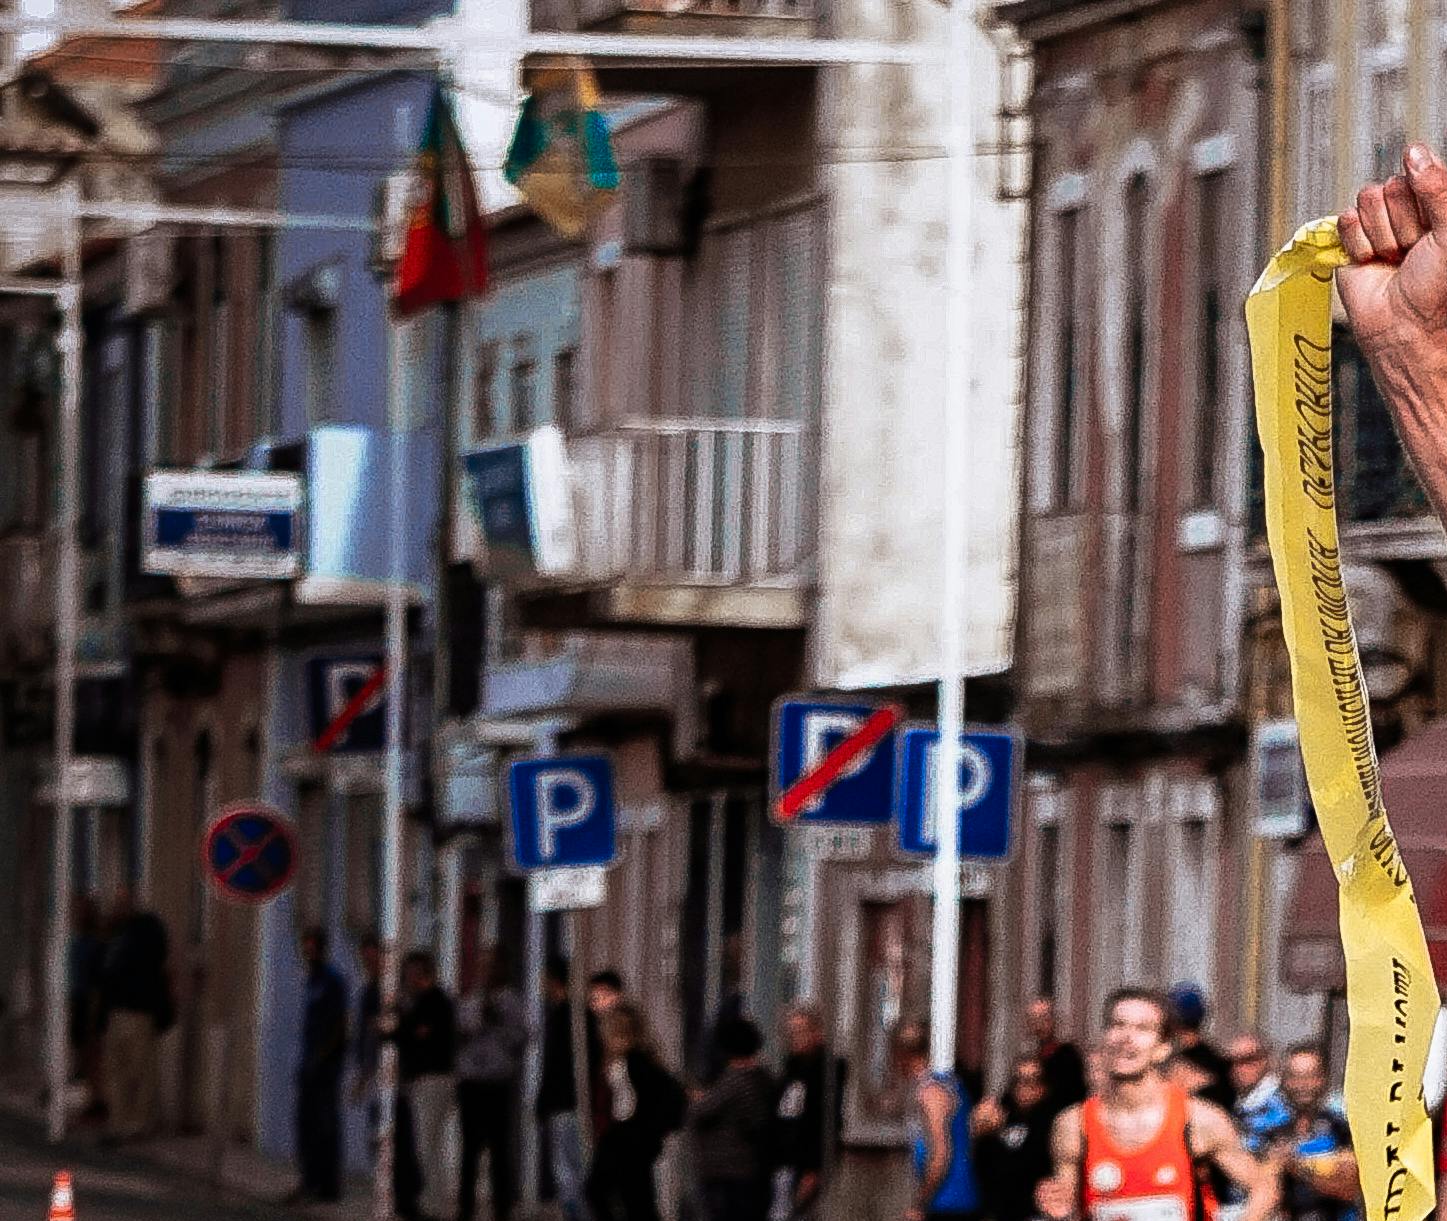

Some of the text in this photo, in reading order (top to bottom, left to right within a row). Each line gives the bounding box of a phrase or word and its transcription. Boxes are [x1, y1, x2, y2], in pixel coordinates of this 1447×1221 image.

[802, 712, 880, 813] P
[921, 743, 993, 846] P
[535, 769, 597, 859] P
